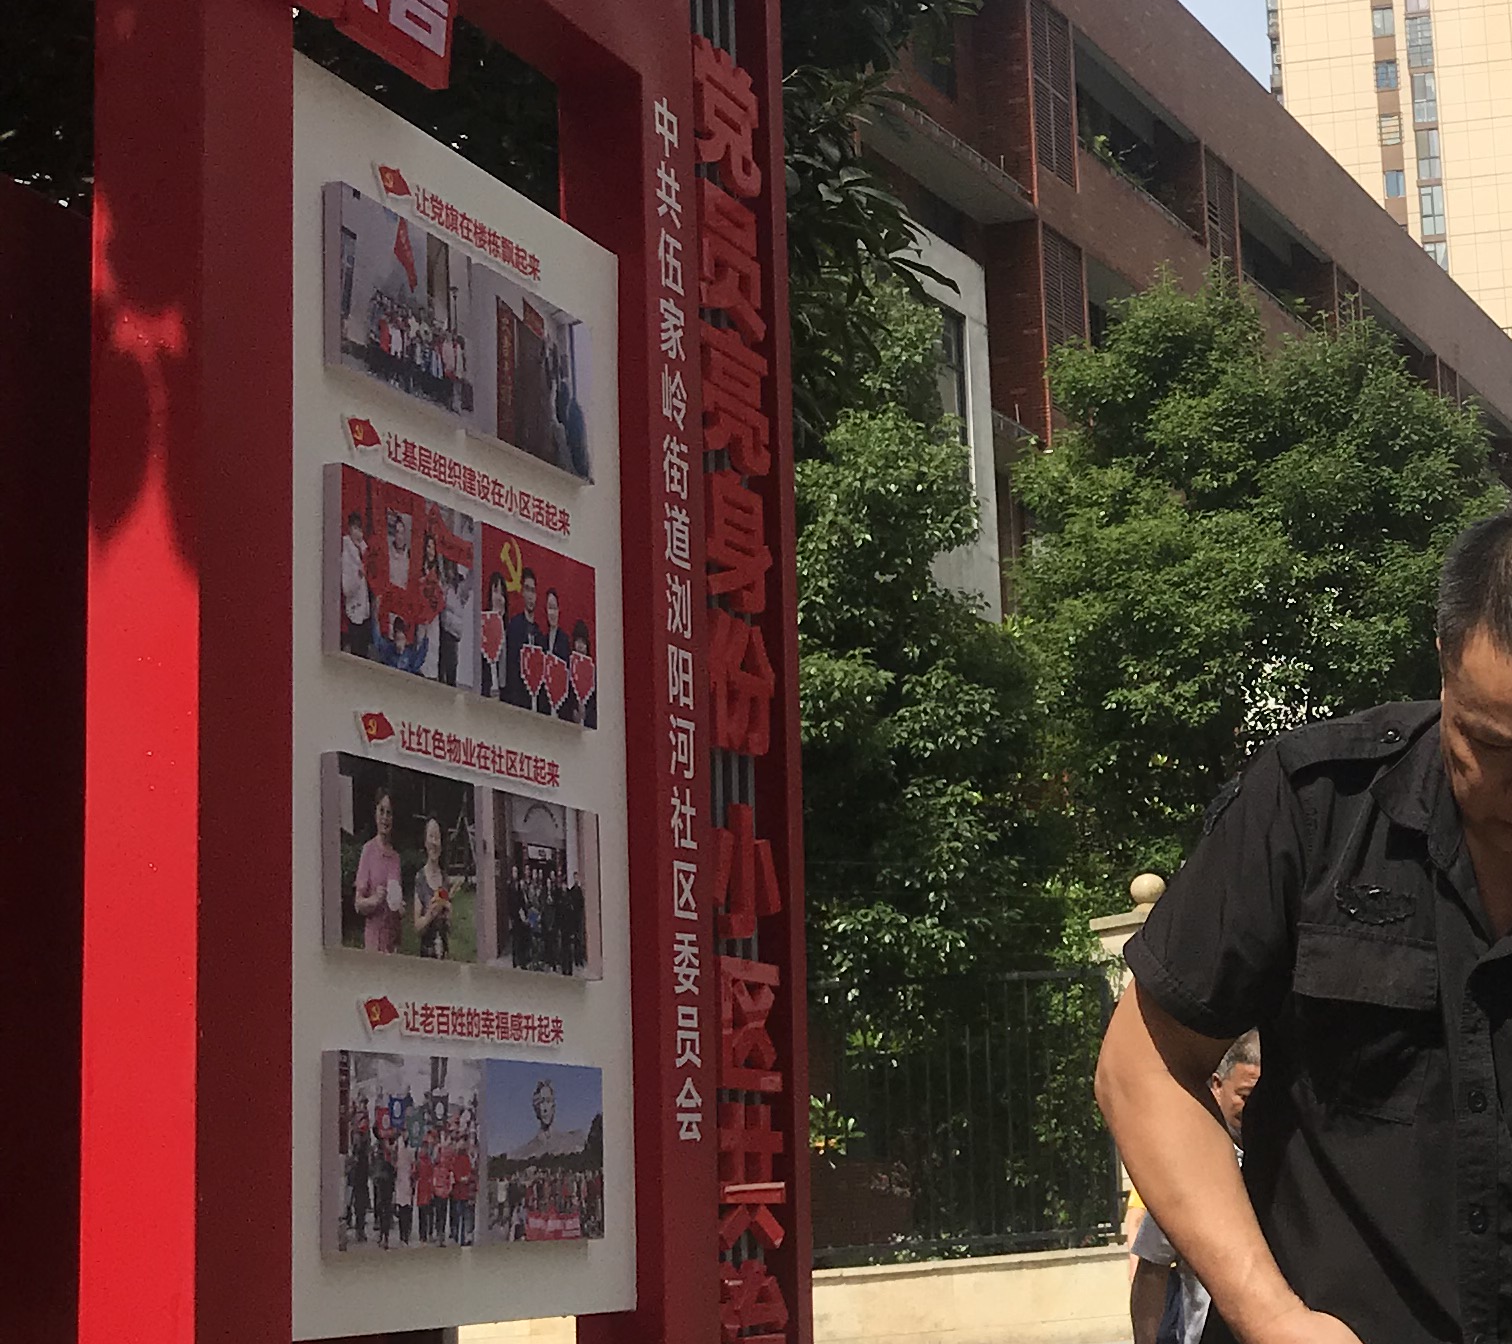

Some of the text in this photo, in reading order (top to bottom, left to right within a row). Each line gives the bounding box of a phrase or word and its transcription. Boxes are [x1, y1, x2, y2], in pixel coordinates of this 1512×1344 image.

[414, 185, 542, 282] 让党旗在楼栋飘起来
[385, 431, 572, 536] 让基层组织建设在小区活起来
[652, 96, 703, 1143] 中共伍家岭街道浏阳河社区委员会
[399, 720, 561, 788] 让红色物业在社区红起来
[403, 1001, 565, 1045] 让老百姓的幸福感升起来
